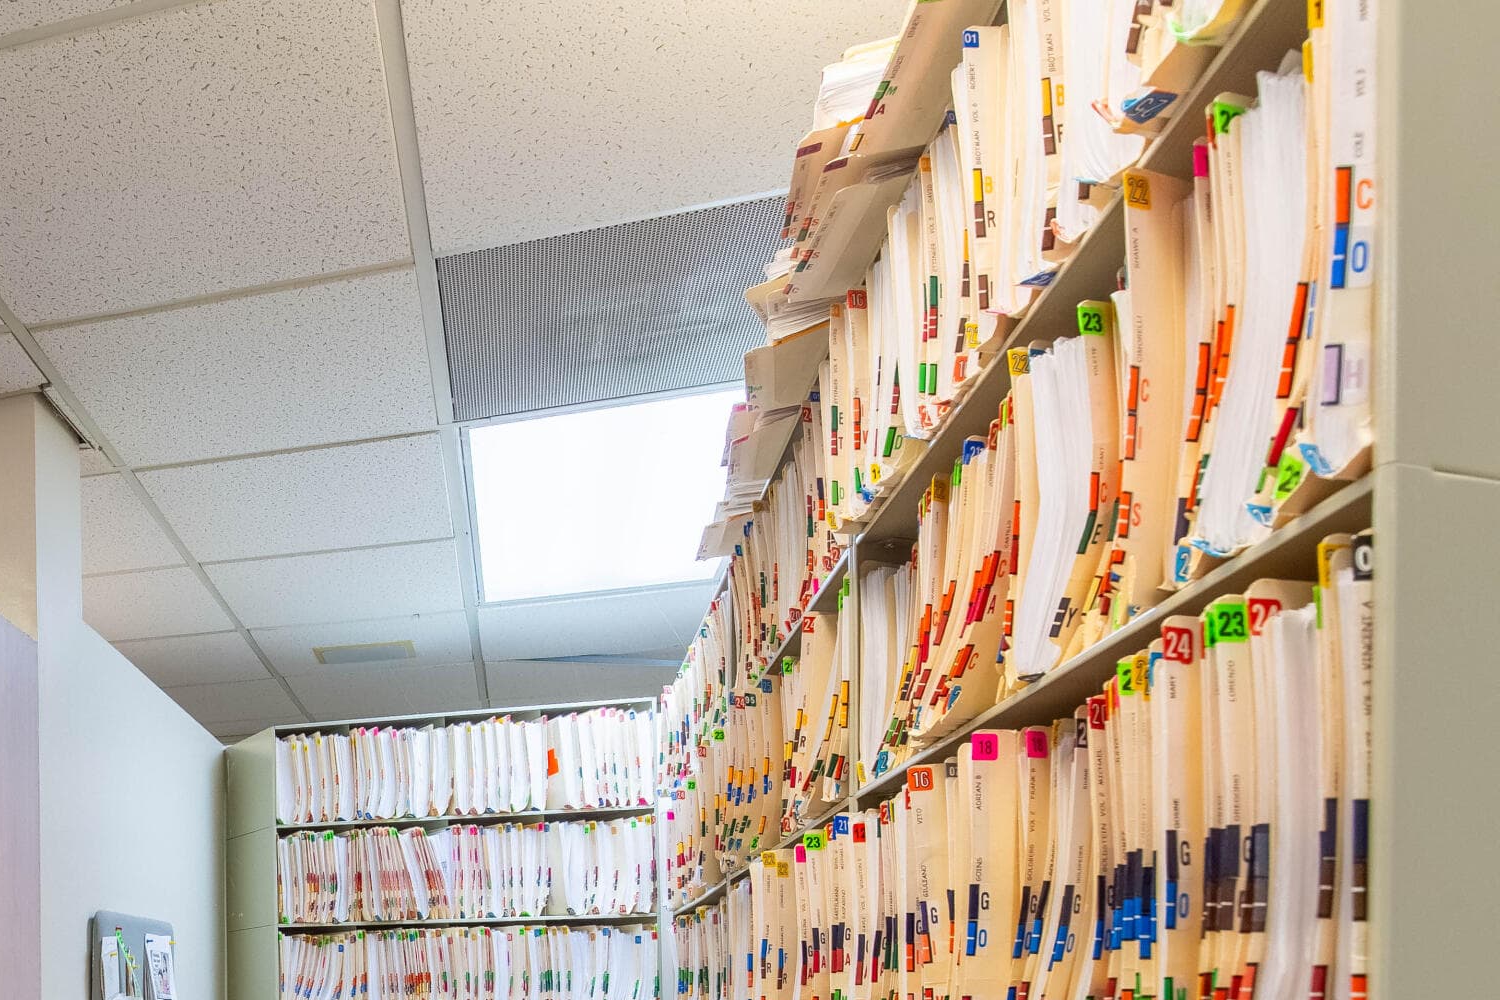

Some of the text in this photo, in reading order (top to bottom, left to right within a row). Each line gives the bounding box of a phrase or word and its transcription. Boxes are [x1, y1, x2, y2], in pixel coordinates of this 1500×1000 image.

[963, 32, 978, 46] 01
[1355, 178, 1374, 210] C
[1082, 313, 1103, 332] 23
[1218, 611, 1246, 637] 23
[1165, 631, 1192, 660] 24
[978, 740, 993, 755] 18
[912, 771, 930, 788] 16
[806, 836, 821, 849] 23
[1180, 840, 1191, 866] G
[981, 892, 990, 910] G
[930, 907, 938, 924] G
